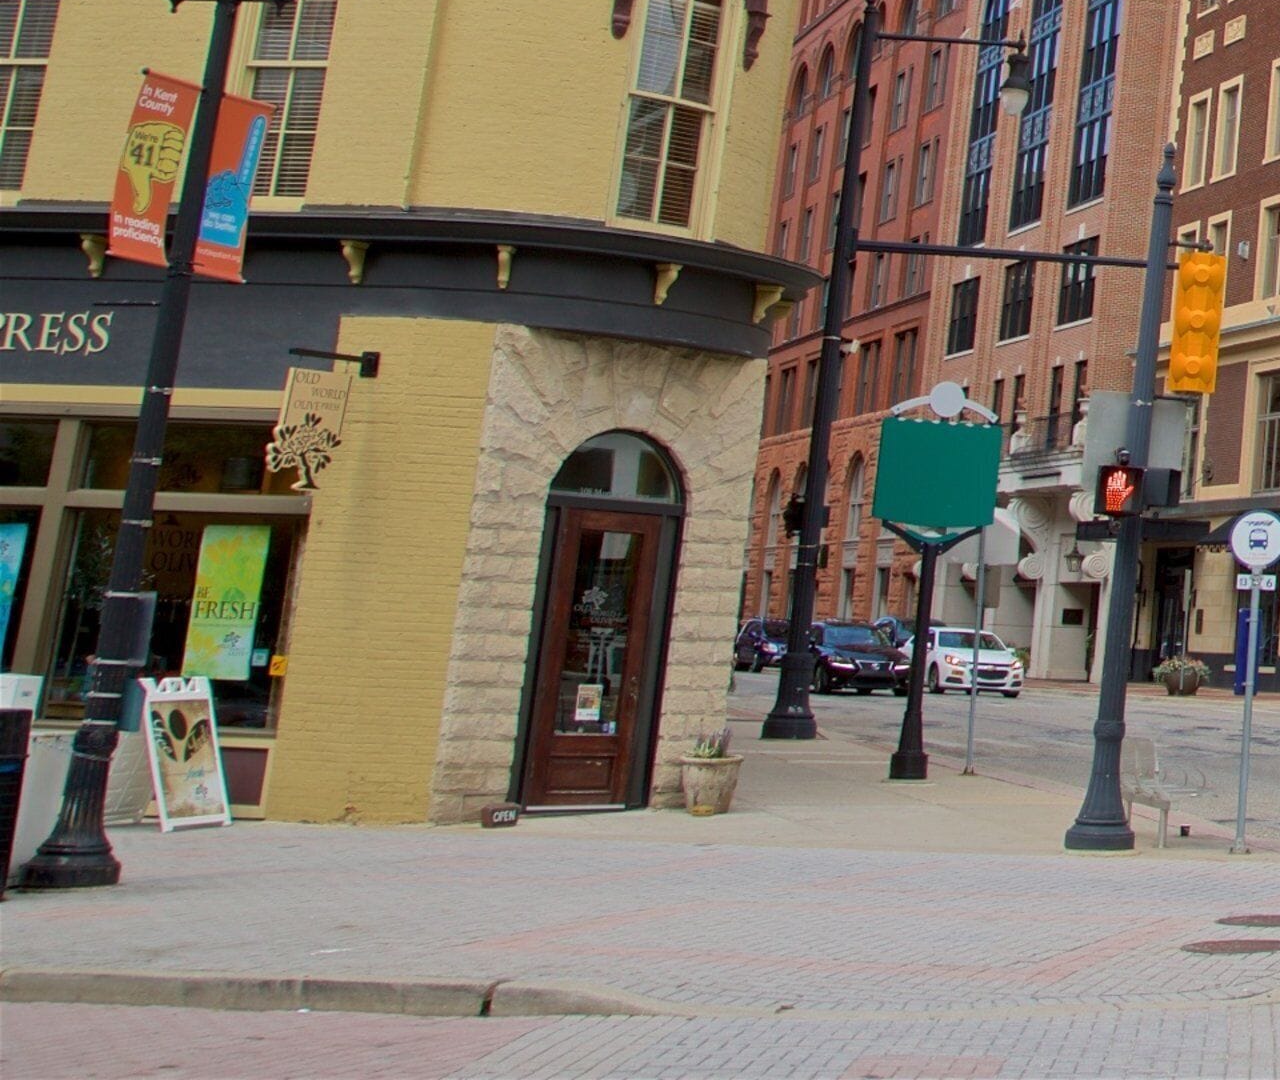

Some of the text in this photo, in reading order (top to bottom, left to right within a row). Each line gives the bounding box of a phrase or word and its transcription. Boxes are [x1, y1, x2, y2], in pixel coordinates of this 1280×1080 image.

[154, 87, 178, 103] Kent
[138, 95, 174, 117] County
[114, 211, 160, 235] in reading
[295, 371, 321, 385] OLD
[312, 386, 346, 400] WORLD
[294, 400, 322, 411] OLIVE
[152, 530, 200, 548] WOR
[1266, 578, 1273, 588] 6
[197, 585, 210, 599] BE
[194, 601, 256, 620] FRESH
[492, 809, 517, 823] OPEN
